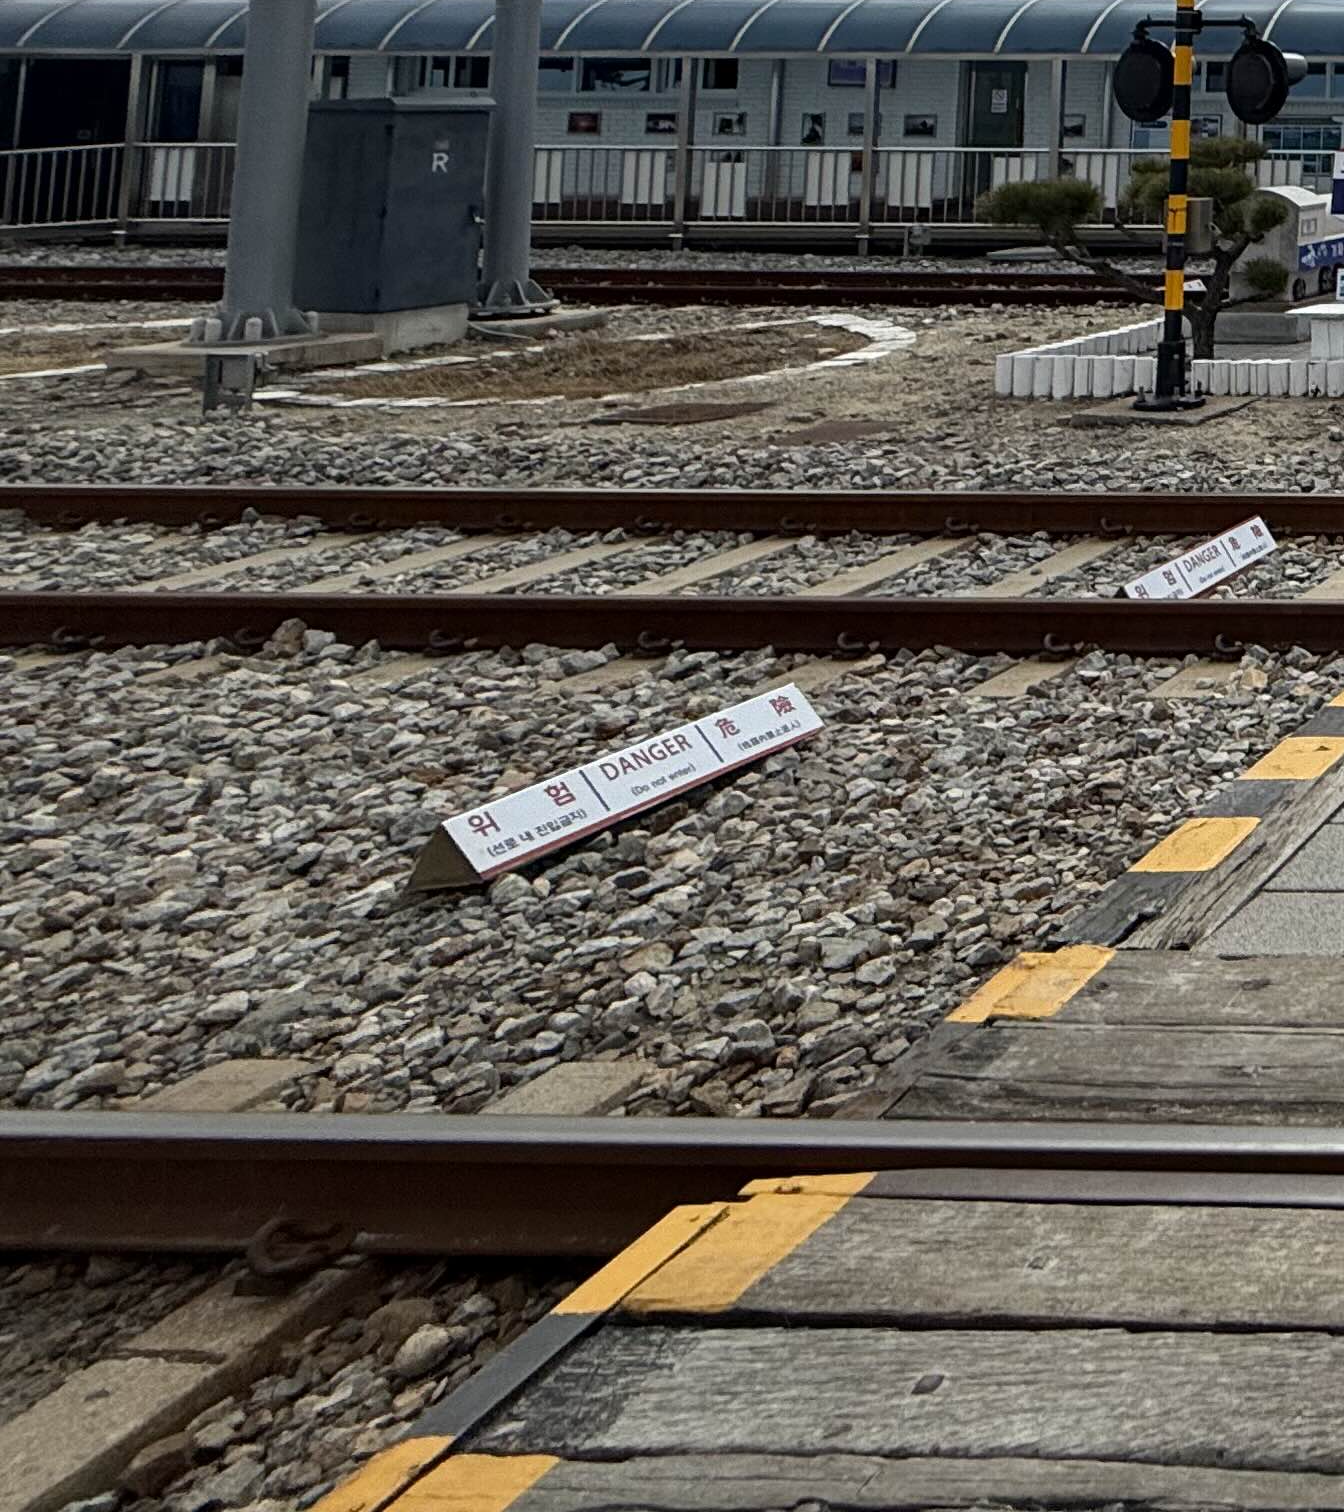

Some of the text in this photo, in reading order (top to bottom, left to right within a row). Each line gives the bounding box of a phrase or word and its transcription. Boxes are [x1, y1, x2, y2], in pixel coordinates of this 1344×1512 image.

[432, 152, 449, 173] R
[1182, 544, 1222, 573] DANGER
[599, 733, 694, 782] DANGER
[631, 779, 650, 798] (Do
